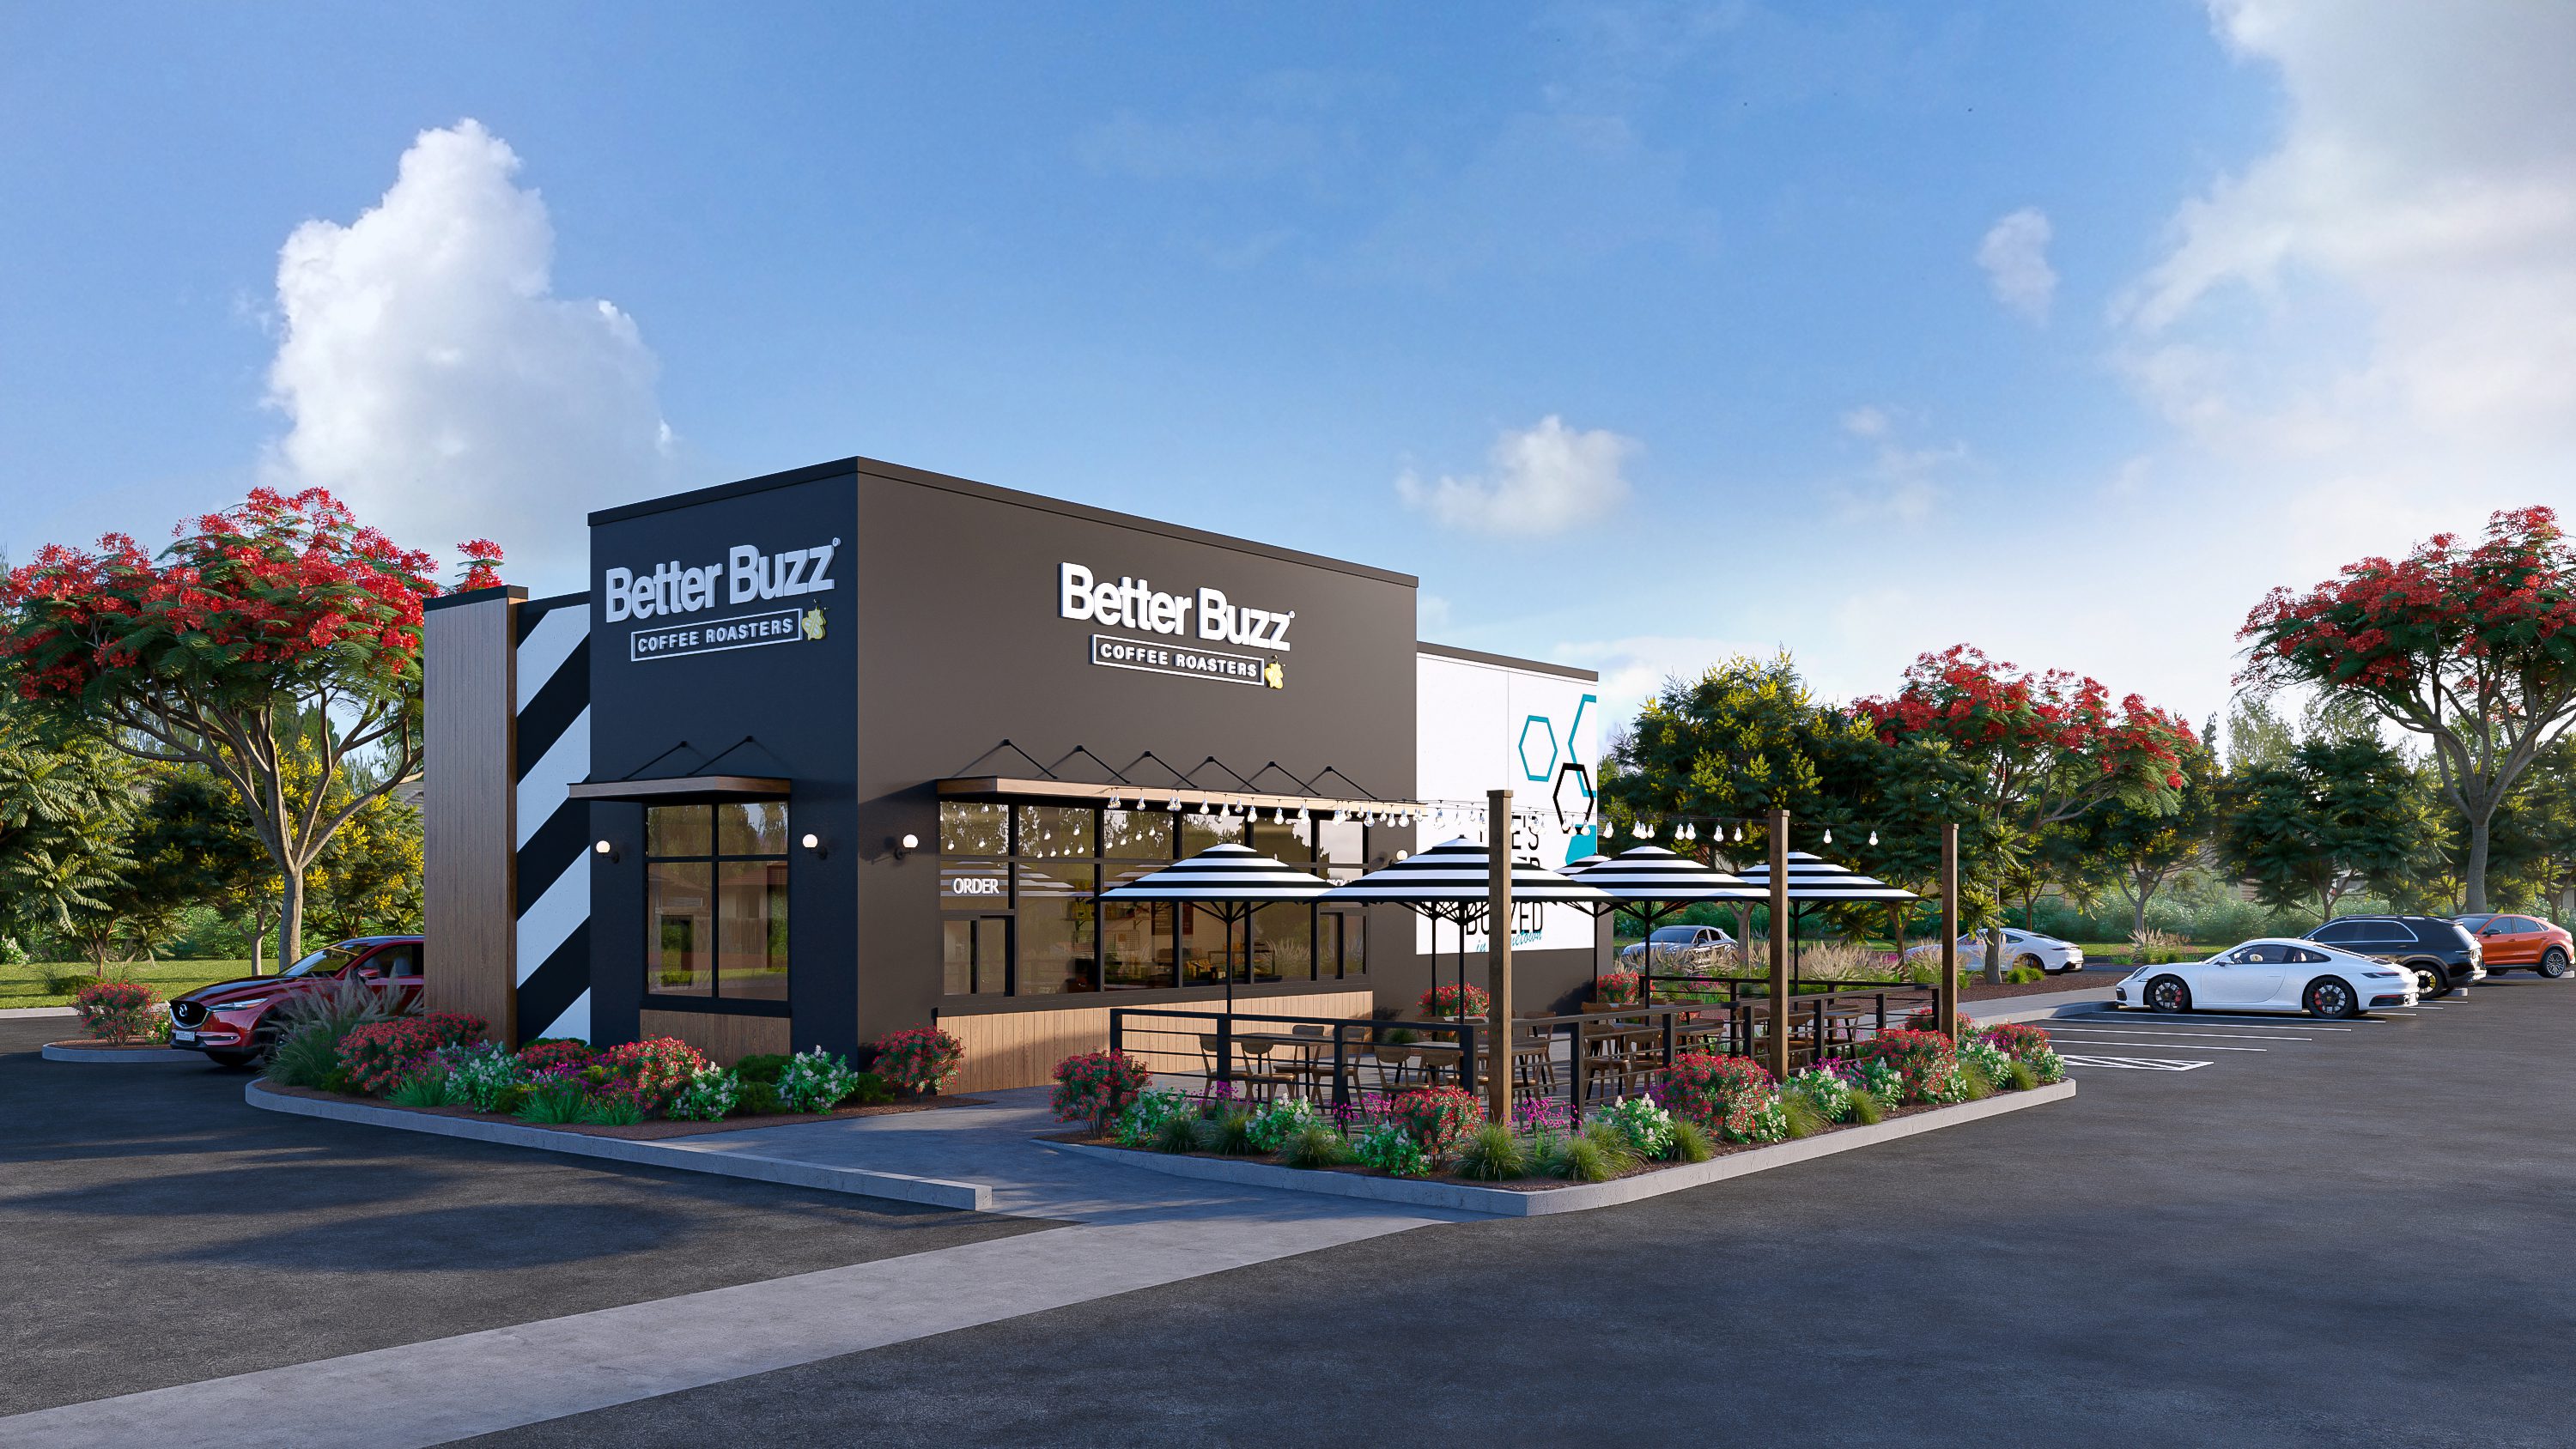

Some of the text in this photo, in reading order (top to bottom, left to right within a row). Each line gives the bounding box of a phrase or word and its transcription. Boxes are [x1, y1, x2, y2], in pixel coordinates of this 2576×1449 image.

[606, 561, 722, 622] Better
[1060, 561, 1192, 635] Better
[638, 618, 793, 652] COFFEE ROASTERS
[1099, 643, 1257, 677] COFFEE ROASTERS
[953, 877, 999, 894] ORDER
